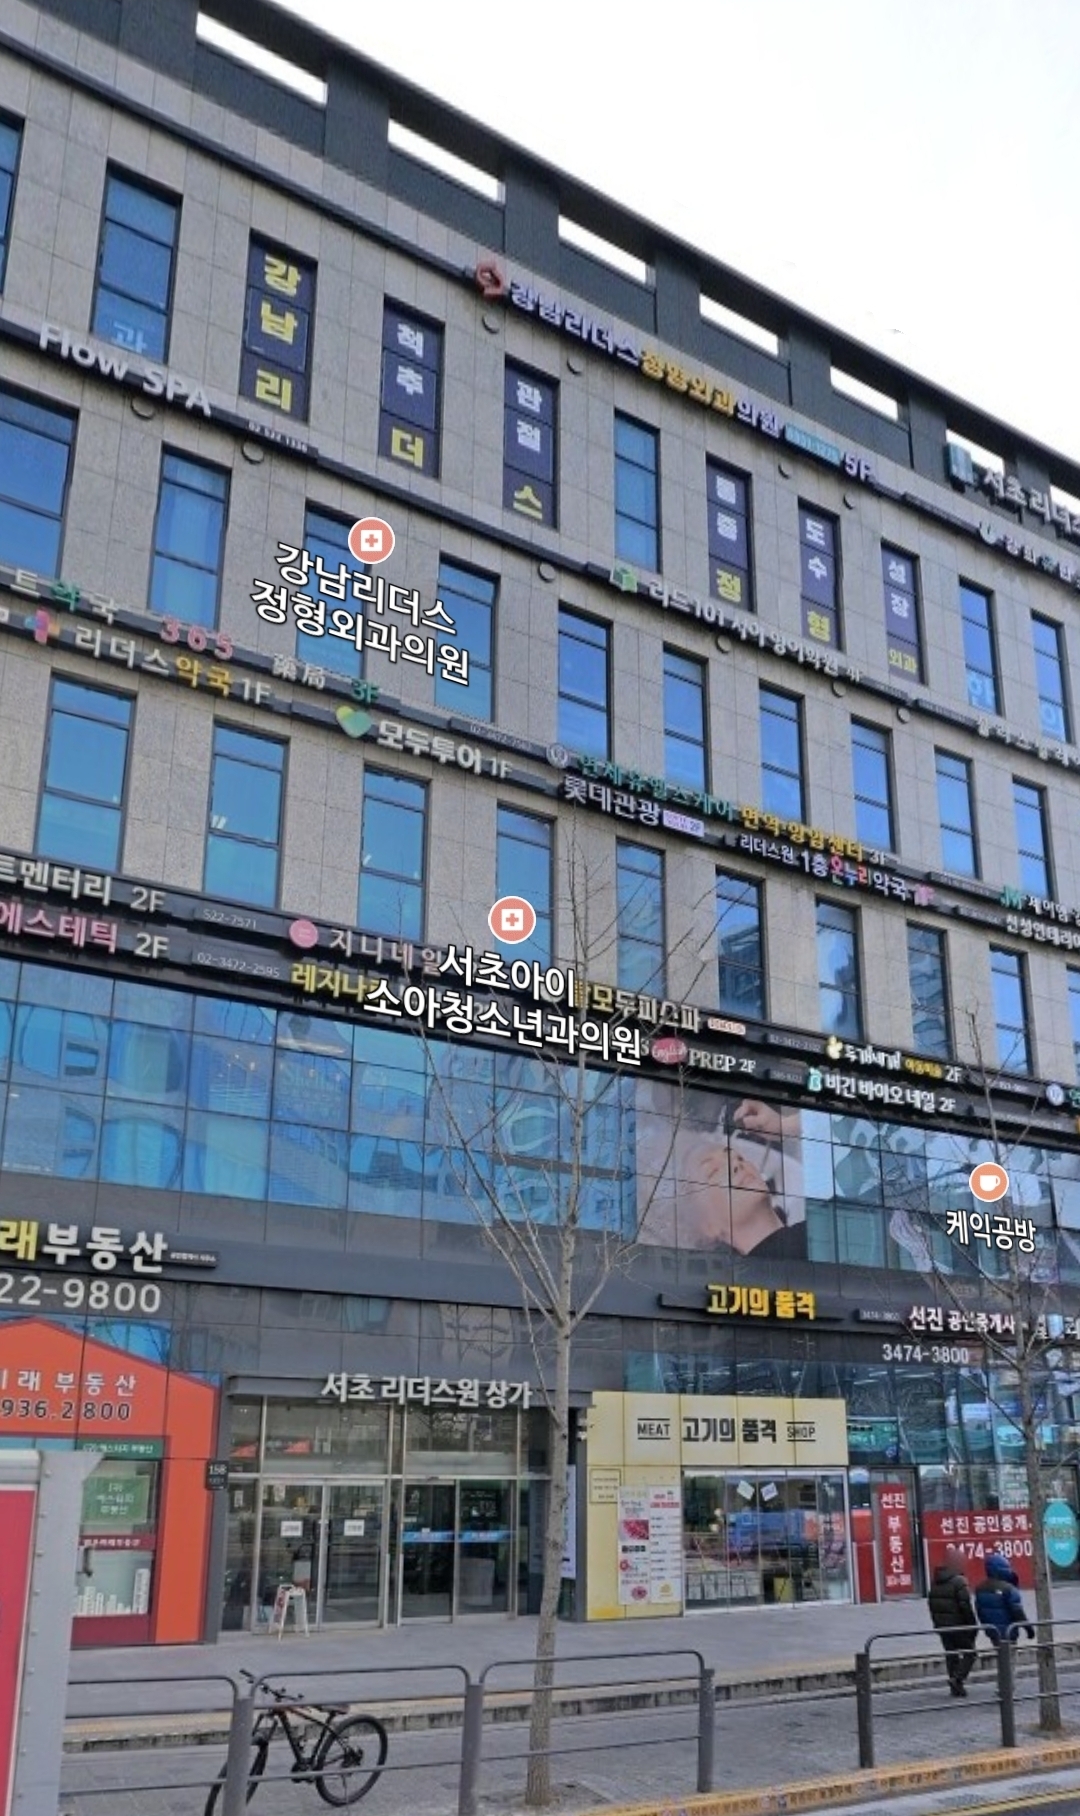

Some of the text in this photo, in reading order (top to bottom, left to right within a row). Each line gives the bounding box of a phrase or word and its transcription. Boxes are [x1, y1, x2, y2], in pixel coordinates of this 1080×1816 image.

[143, 366, 211, 417] SPA
[75, 624, 272, 705] 리더스약국 1F
[377, 718, 483, 775] 모두투어
[488, 756, 515, 779] 1F
[130, 885, 167, 913] 2F
[134, 932, 170, 960] 2F
[689, 1048, 736, 1073] PREP
[945, 1064, 963, 1083] 2F
[938, 1096, 957, 1113] 2F
[706, 1283, 816, 1320] 고기의 품격
[882, 1343, 970, 1365] 3474-3800
[321, 1372, 533, 1409] 서초 리더스원 상가
[637, 1417, 816, 1443] MEAT 고기의 품격 SHOP
[940, 1517, 970, 1535] 선진
[974, 1514, 1032, 1534] 공인중개
